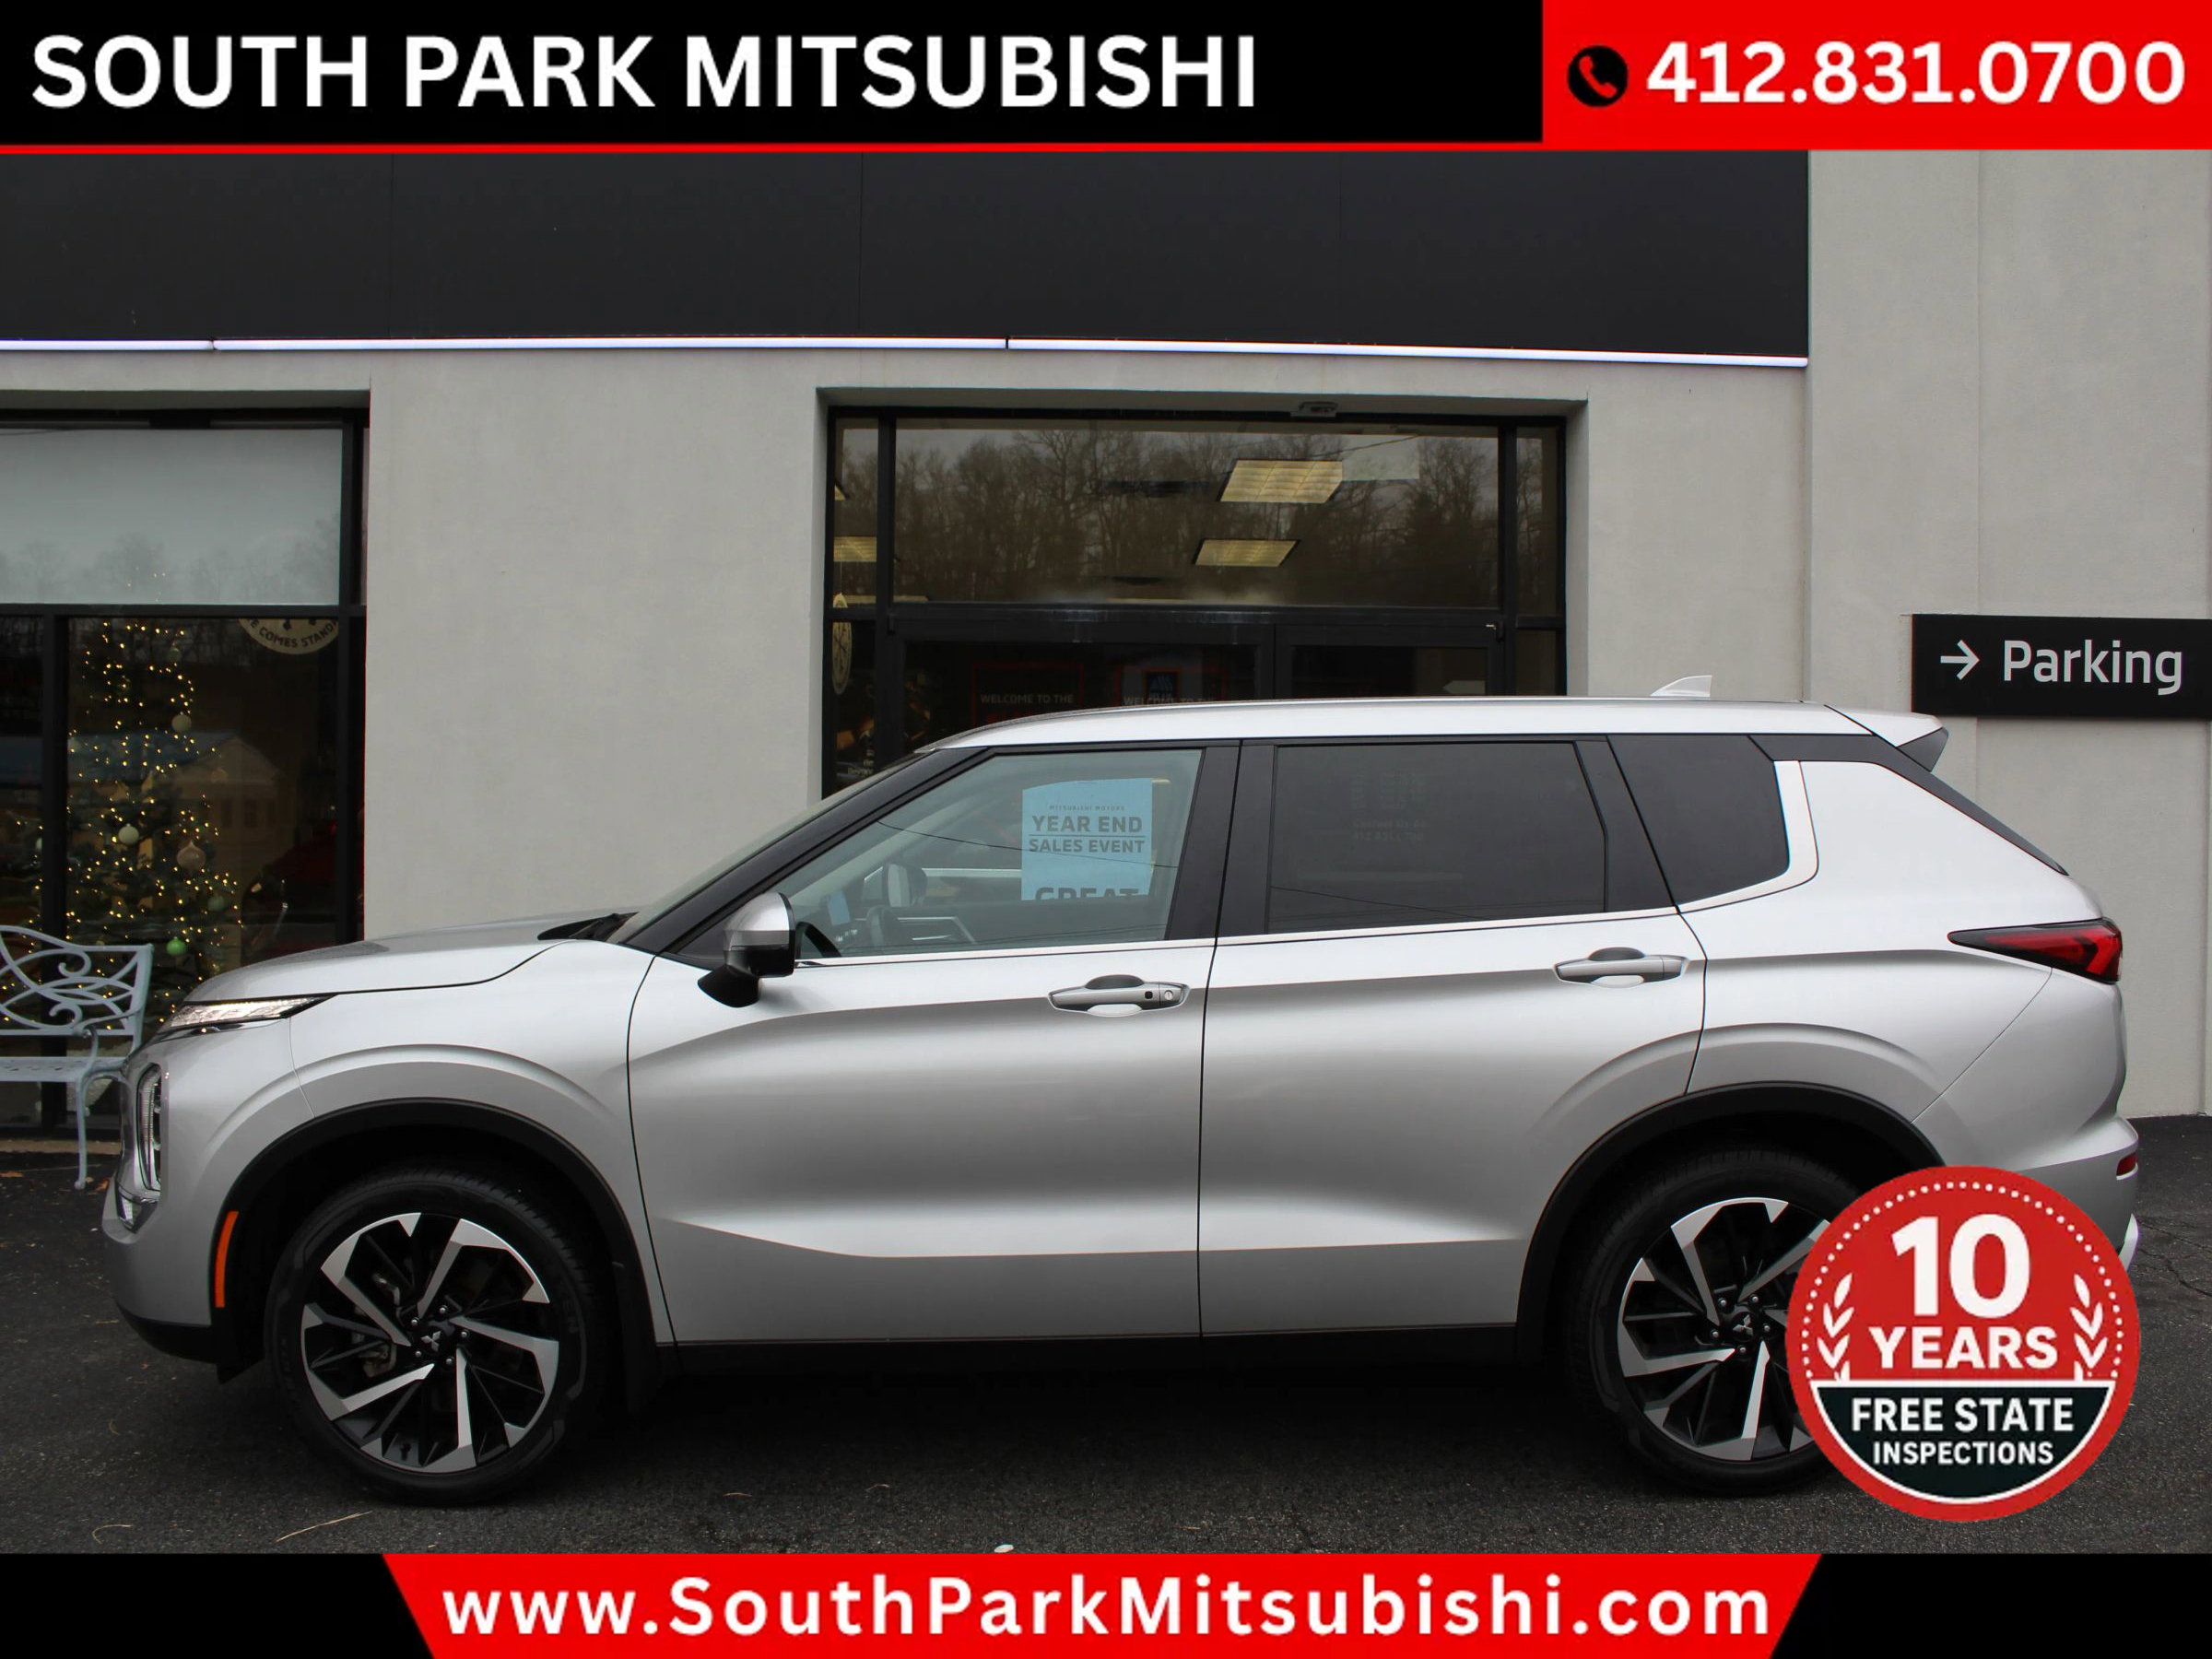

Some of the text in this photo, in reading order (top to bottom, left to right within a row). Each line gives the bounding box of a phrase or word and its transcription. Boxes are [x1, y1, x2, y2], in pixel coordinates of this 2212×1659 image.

[259, 627, 298, 647] COMES
[2004, 640, 2183, 695] Parking
[981, 694, 1074, 704] WELCOME TO THE
[1031, 815, 1143, 833] YEAR END
[1029, 839, 1145, 853] SALES EVENT
